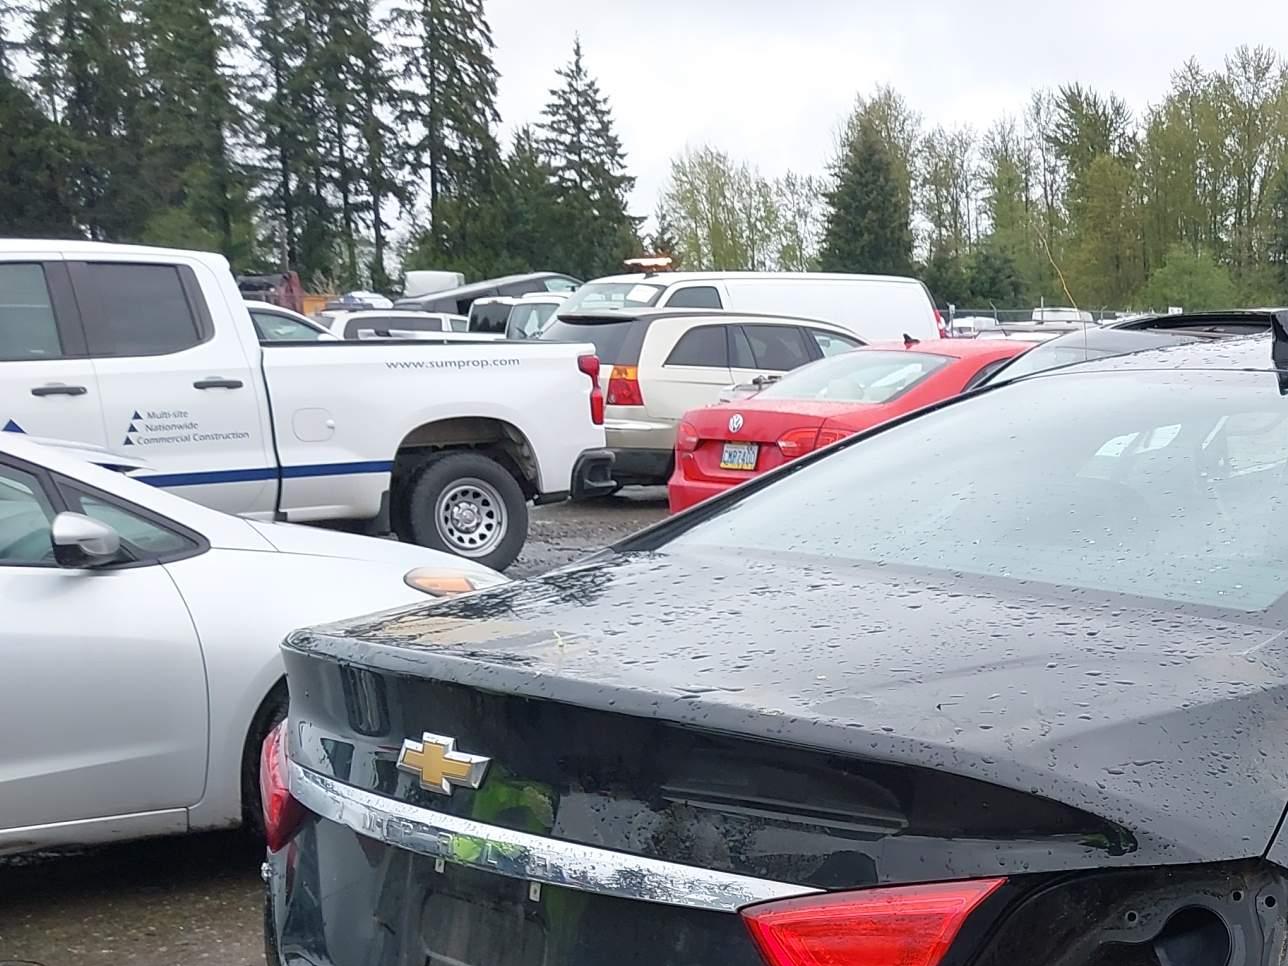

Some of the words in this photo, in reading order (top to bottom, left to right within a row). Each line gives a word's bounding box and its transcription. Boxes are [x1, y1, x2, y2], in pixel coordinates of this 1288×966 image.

[385, 357, 520, 370] www.sumprop.com
[146, 410, 189, 420] Multi-site
[145, 422, 199, 432] Nationwide
[136, 434, 191, 446] Commercial
[193, 431, 250, 442] Construction
